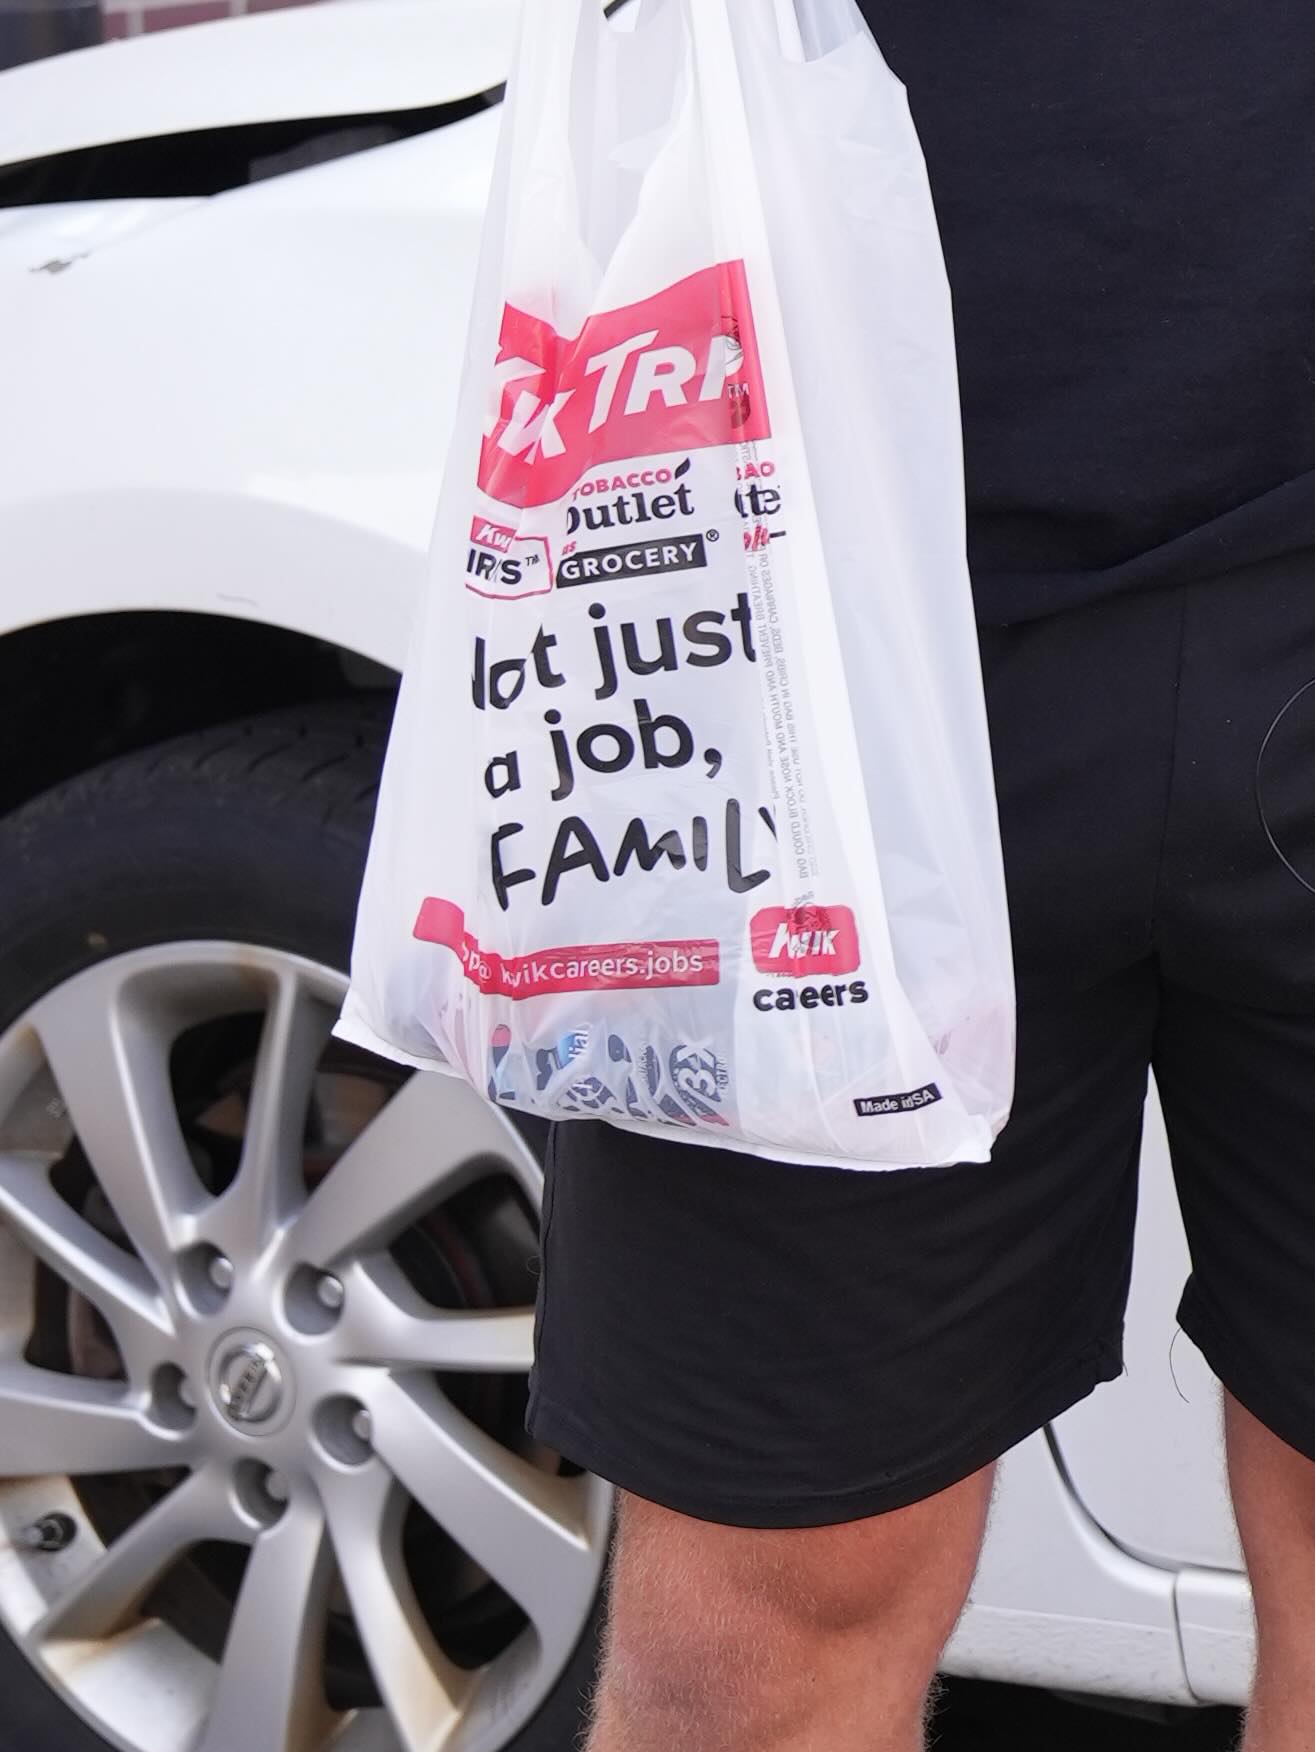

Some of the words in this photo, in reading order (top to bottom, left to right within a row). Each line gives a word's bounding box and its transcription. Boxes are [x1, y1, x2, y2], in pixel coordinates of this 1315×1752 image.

[561, 542, 698, 579] GROCERY
[588, 593, 756, 700] just
[485, 750, 521, 799] a
[544, 698, 723, 801] job,
[860, 1098, 898, 1113] Made
